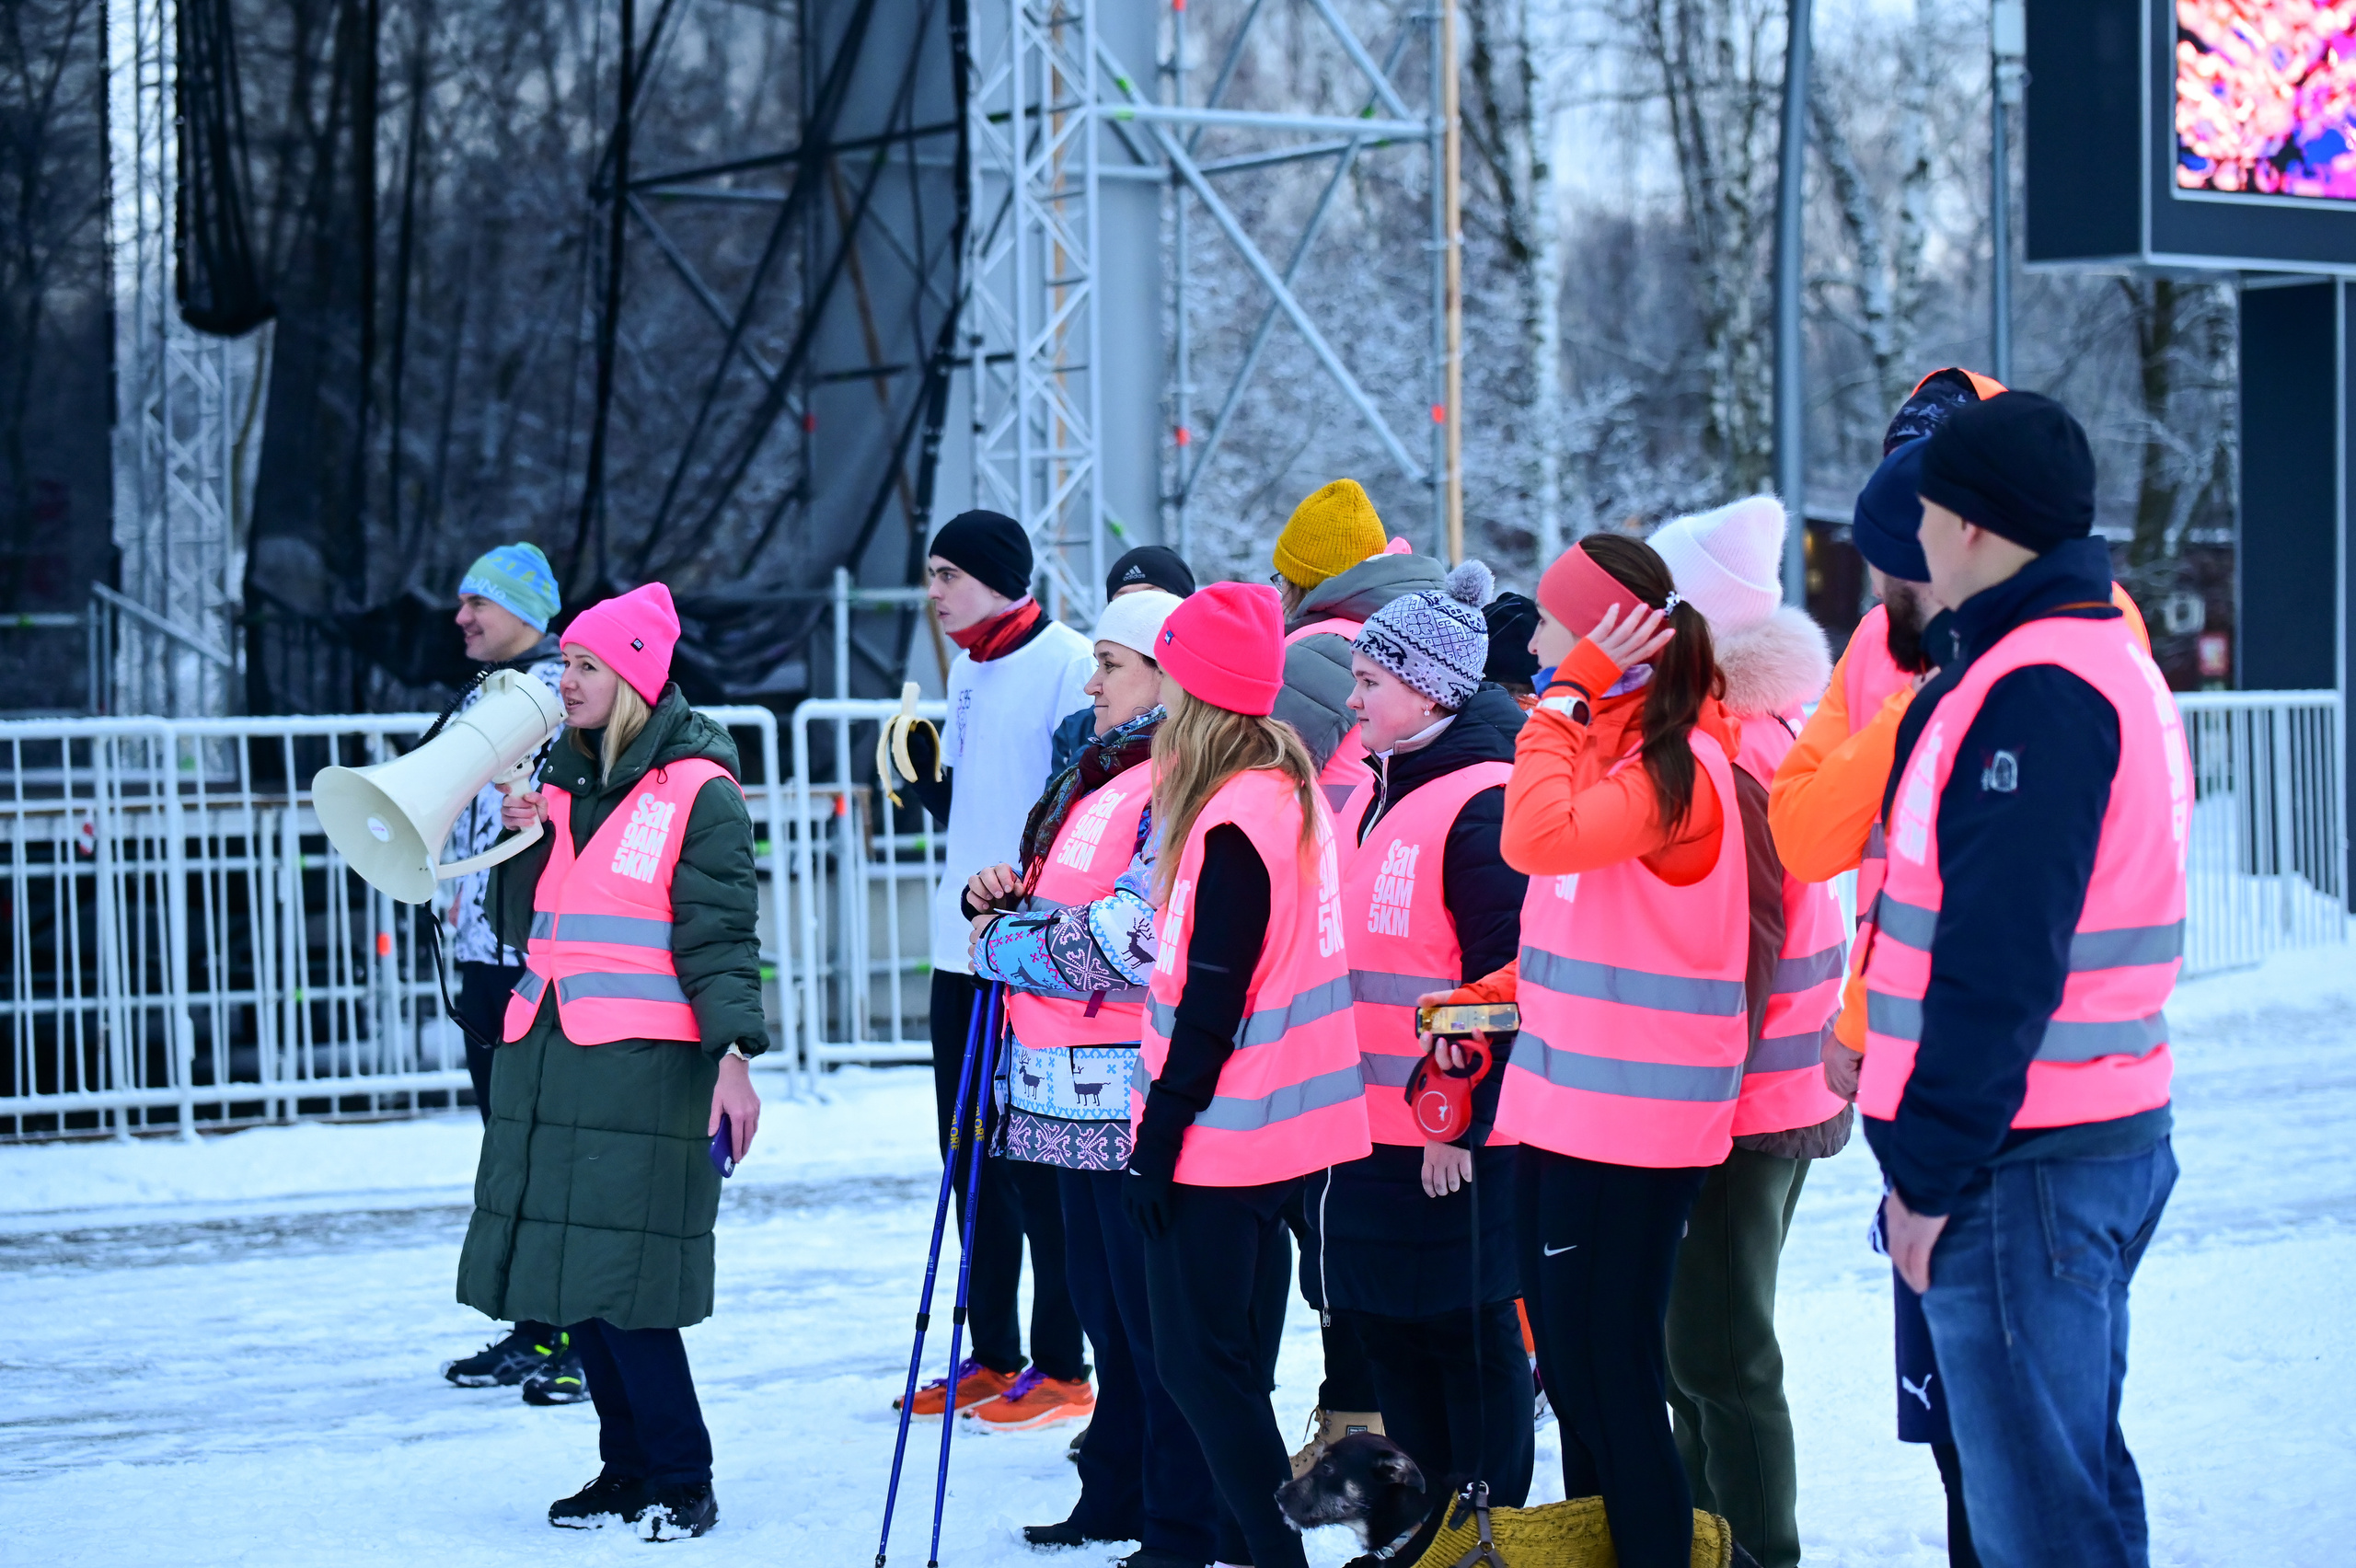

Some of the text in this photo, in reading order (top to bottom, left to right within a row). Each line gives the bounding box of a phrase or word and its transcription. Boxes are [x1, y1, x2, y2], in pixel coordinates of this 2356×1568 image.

[1123, 573, 1147, 582] adidas
[631, 792, 676, 833] Sat
[1088, 788, 1128, 820] Sat
[621, 822, 668, 858] 9AM
[1070, 813, 1109, 846] 9AM
[611, 847, 660, 883] 5KM
[1057, 837, 1097, 873] 5KM
[1380, 838, 1420, 880] Sat
[1372, 873, 1415, 909] 9AM
[1368, 903, 1410, 939] 5KM
